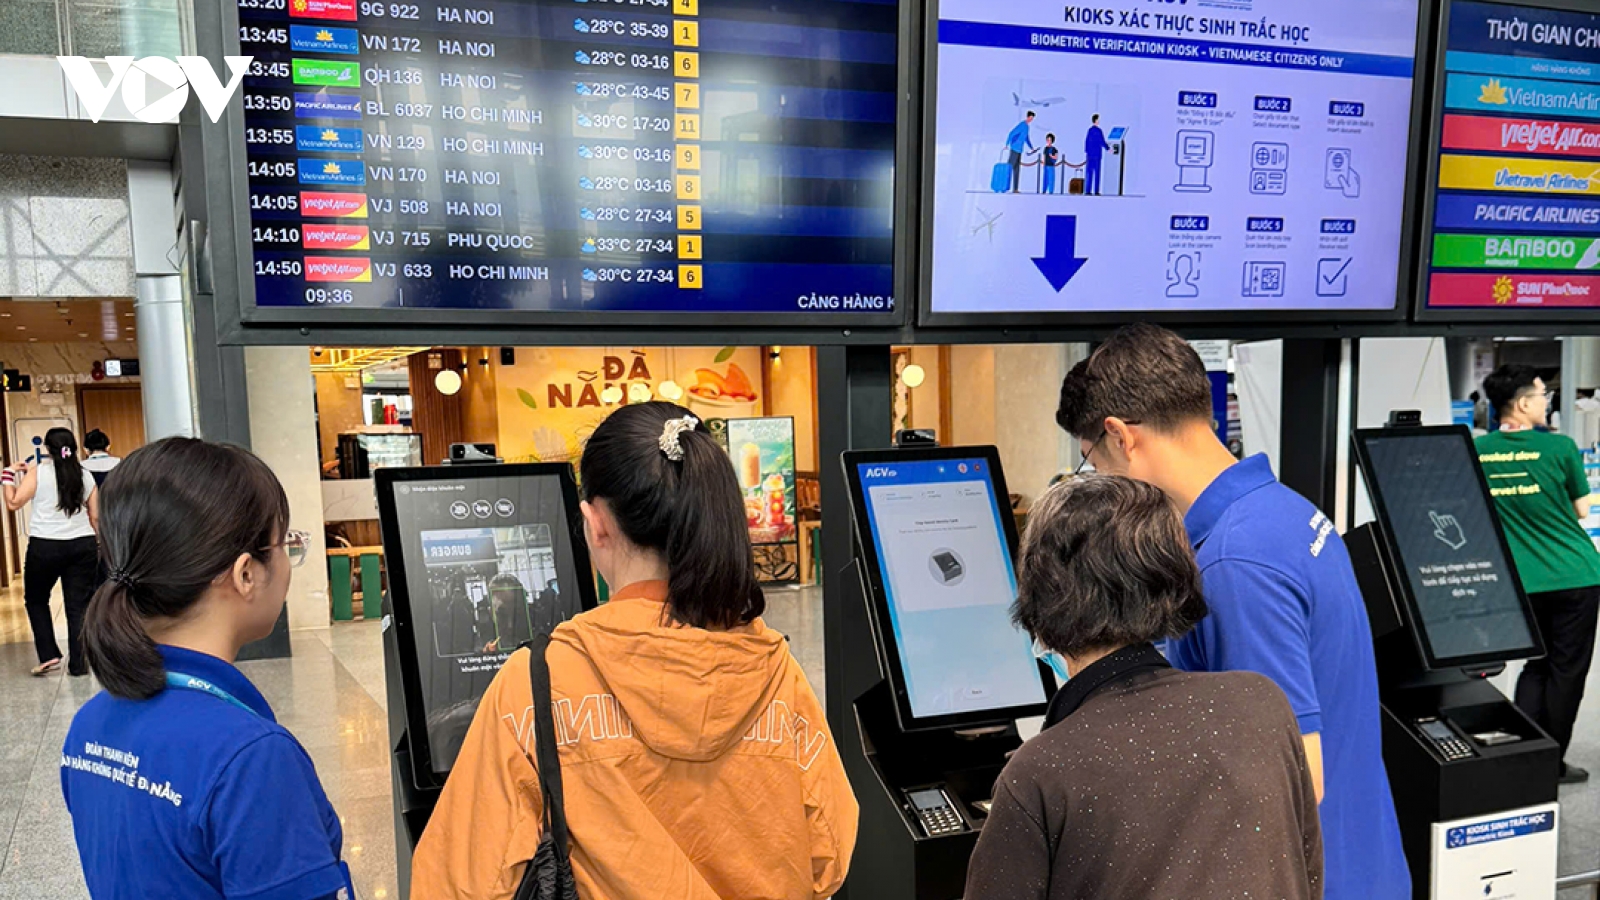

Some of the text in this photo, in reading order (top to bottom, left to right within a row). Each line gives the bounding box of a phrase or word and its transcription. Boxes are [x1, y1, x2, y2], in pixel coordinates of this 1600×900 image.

[361, 2, 385, 16] 9G
[390, 4, 420, 20] 922
[437, 7, 461, 23] HA
[464, 8, 494, 25] NOI
[590, 19, 625, 34] 28°C
[630, 22, 668, 38] 35-39
[682, 26, 690, 39] 1
[1064, 6, 1310, 46] KIOKS XÁC THỰC SINH TRẮC HỌC
[1487, 17, 1600, 49] THỜI GIAN CH
[240, 26, 288, 43] 13:45
[362, 34, 387, 51] VN
[392, 37, 420, 52] 172
[439, 39, 461, 55] HA
[465, 41, 495, 57] NOI
[591, 51, 625, 67] 28°C
[631, 54, 669, 70] 03-16
[682, 58, 691, 71] 6
[1030, 32, 1090, 49] BIOMETRIC
[1093, 38, 1164, 54] VERIFICATION
[1167, 43, 1199, 57] KIOSK
[1208, 47, 1272, 63] VIETNAMESE
[1274, 53, 1318, 67] CITIZENS
[1319, 56, 1345, 68] ONLY
[365, 68, 391, 88] QH
[393, 69, 423, 86] 136
[441, 73, 464, 89] HA
[466, 74, 496, 90] NOI
[592, 82, 626, 97] 28°C
[631, 85, 670, 101] 43-45
[683, 89, 691, 102] 7
[244, 94, 291, 111] 13:50
[367, 101, 390, 116] BL
[394, 103, 432, 119] 6037
[442, 105, 466, 120] HO
[470, 107, 498, 122] CHI
[502, 108, 543, 124] MINH
[593, 114, 627, 130] 30°C
[633, 117, 670, 133] 17-20
[680, 120, 695, 134] 11
[246, 128, 294, 145] 13:55
[367, 134, 393, 149] VN
[396, 136, 425, 151] 129
[443, 138, 467, 153] HO
[472, 140, 499, 155] CHI
[503, 141, 543, 157] MINH
[594, 147, 628, 161] 30°C
[634, 148, 671, 163] 03-16
[683, 150, 693, 164] 9
[248, 162, 296, 178] 14:05
[369, 166, 394, 182] VN
[398, 168, 427, 182] 170
[445, 170, 468, 184] HA
[472, 171, 500, 185] NOI
[595, 177, 629, 191] 28°C
[634, 179, 672, 193] 03-16
[684, 181, 693, 194] 8
[1547, 173, 1590, 191] Airlines
[251, 195, 298, 210] 14:05
[371, 198, 392, 213] VJ
[400, 199, 429, 214] 508
[446, 201, 469, 216] HA
[473, 203, 501, 217] NOI
[596, 207, 630, 221] 28°C
[635, 209, 673, 224] 27-34
[685, 211, 694, 224] 5
[1474, 204, 1600, 224] PACIFIC AIRLINES
[253, 228, 300, 243] 14:10
[373, 231, 395, 245] VJ
[401, 232, 431, 246] 715
[448, 234, 482, 248] PHU
[488, 235, 533, 251] QUOC
[597, 238, 631, 252] 33°C
[636, 239, 674, 253] 27-34
[686, 241, 694, 254] 1
[1485, 238, 1575, 259] BAMBOO
[255, 260, 302, 276] 14:50
[375, 263, 396, 277] VJ
[404, 264, 432, 278] 633
[450, 264, 475, 279] HO
[480, 266, 505, 280] CHI
[509, 266, 549, 281] MINH
[597, 269, 632, 282] 30°C
[636, 270, 674, 284] 27-34
[686, 270, 694, 283] 6
[305, 288, 353, 304] 09:36
[798, 292, 840, 309] CẢNG
[843, 292, 884, 309] HÀNG
[1516, 282, 1541, 295] SUN
[601, 350, 651, 380] ĐÀ
[1515, 451, 1541, 461] slow
[1518, 484, 1541, 495] fast
[188, 678, 211, 690] ACV
